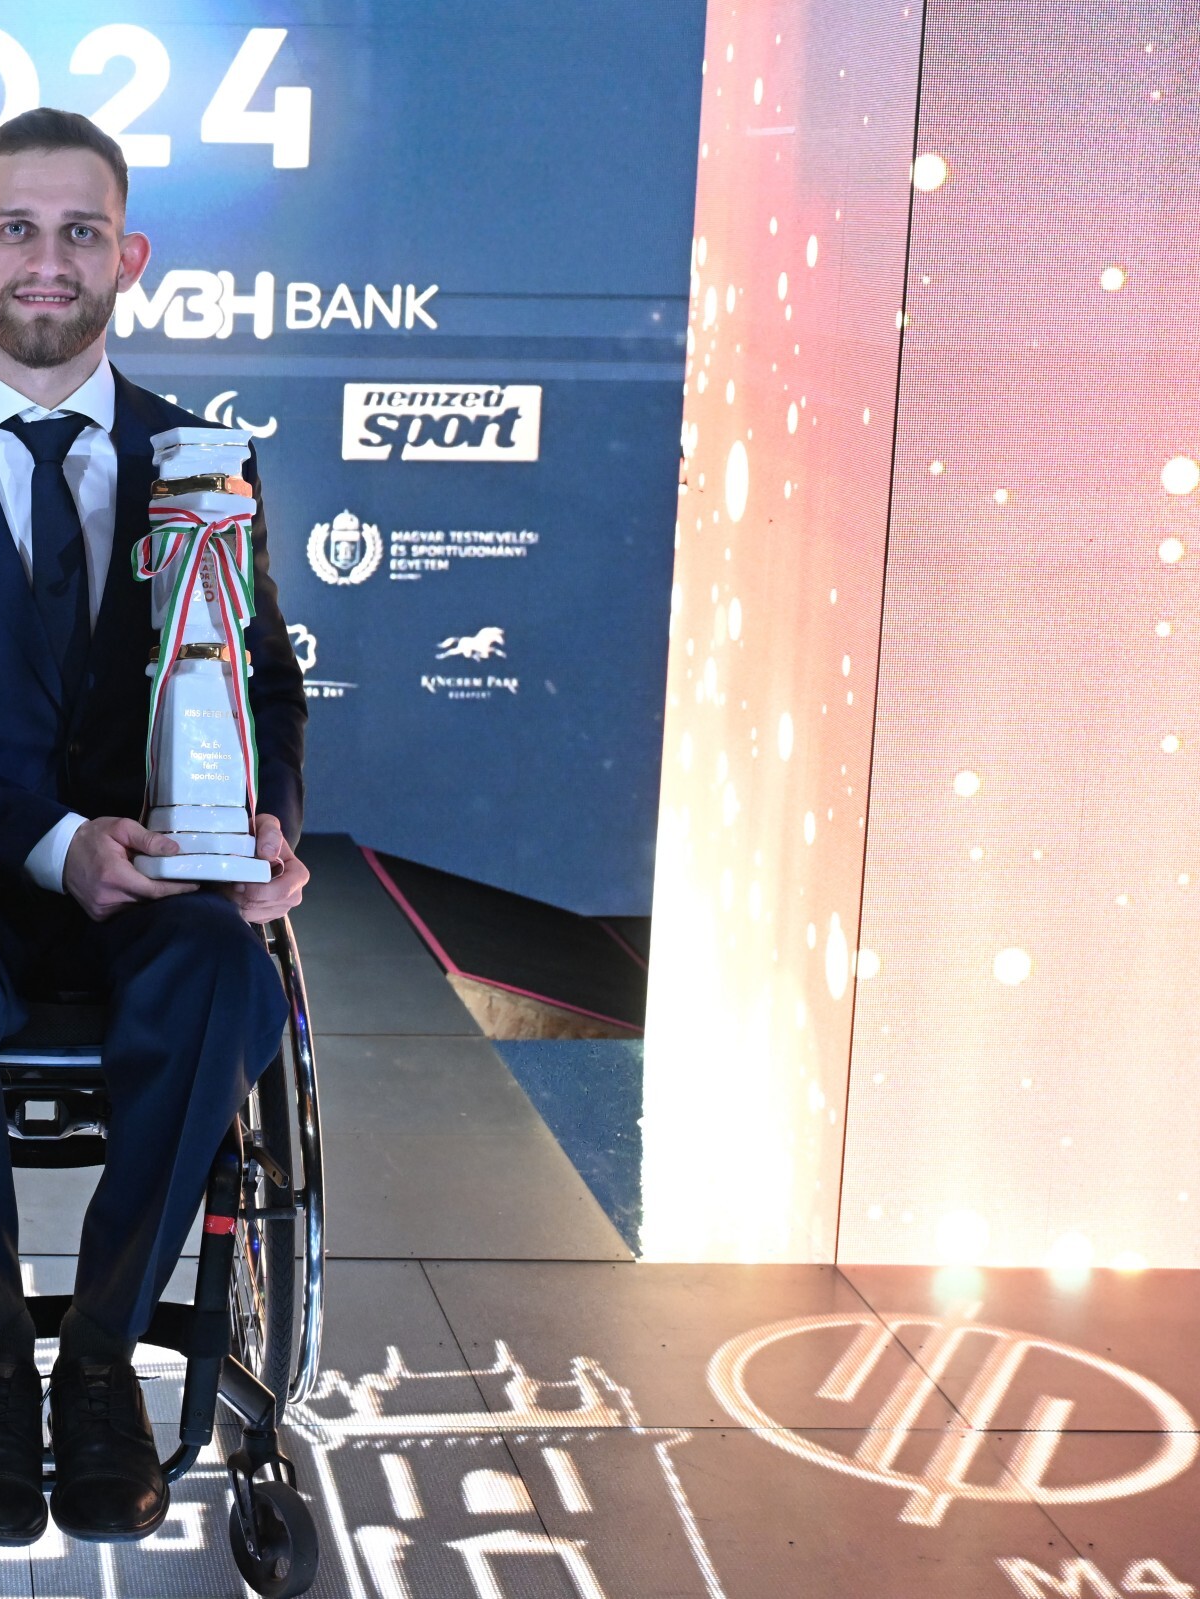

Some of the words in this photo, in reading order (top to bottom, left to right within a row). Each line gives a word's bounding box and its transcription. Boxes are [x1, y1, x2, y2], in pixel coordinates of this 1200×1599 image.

[114, 269, 274, 340] MBH
[285, 282, 440, 330] BANK
[363, 387, 506, 408] nemzeti
[359, 407, 522, 460] sport
[391, 530, 444, 543] MAGYAR
[389, 558, 449, 571] EGYETEM
[193, 590, 215, 602] 20
[184, 709, 200, 718] KISS
